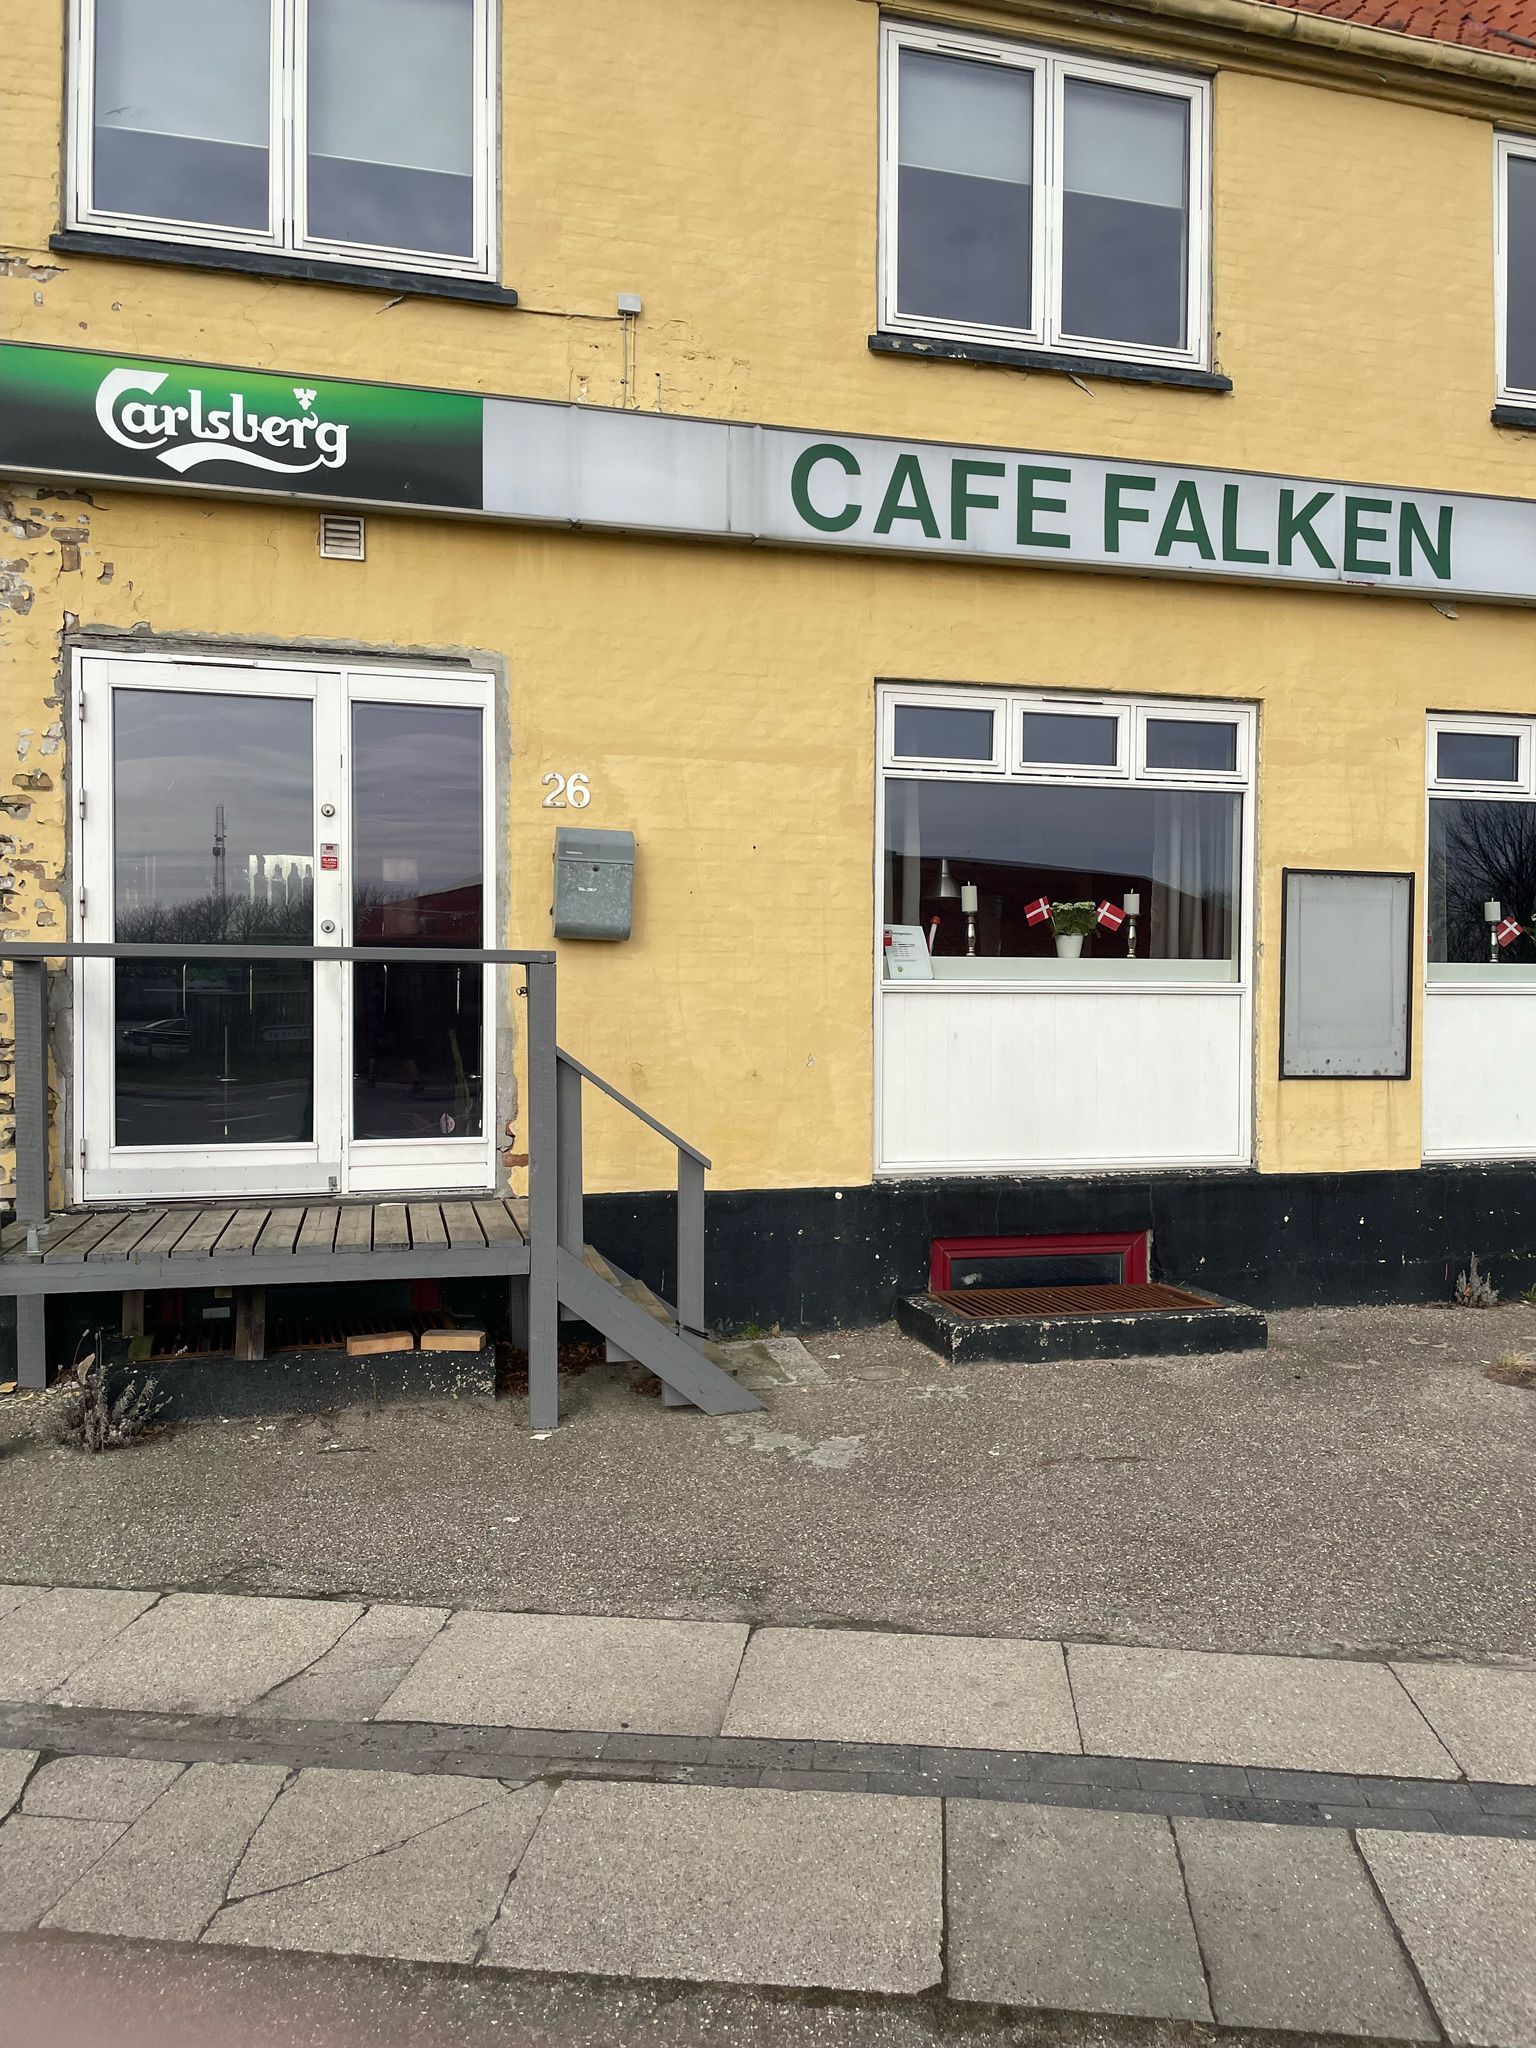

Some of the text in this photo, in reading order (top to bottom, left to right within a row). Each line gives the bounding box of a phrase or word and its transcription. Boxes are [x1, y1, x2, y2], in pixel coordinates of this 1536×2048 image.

[95, 367, 350, 471] Carlsberg
[792, 444, 1453, 580] CAFE FALKEN
[541, 772, 592, 809] 26
